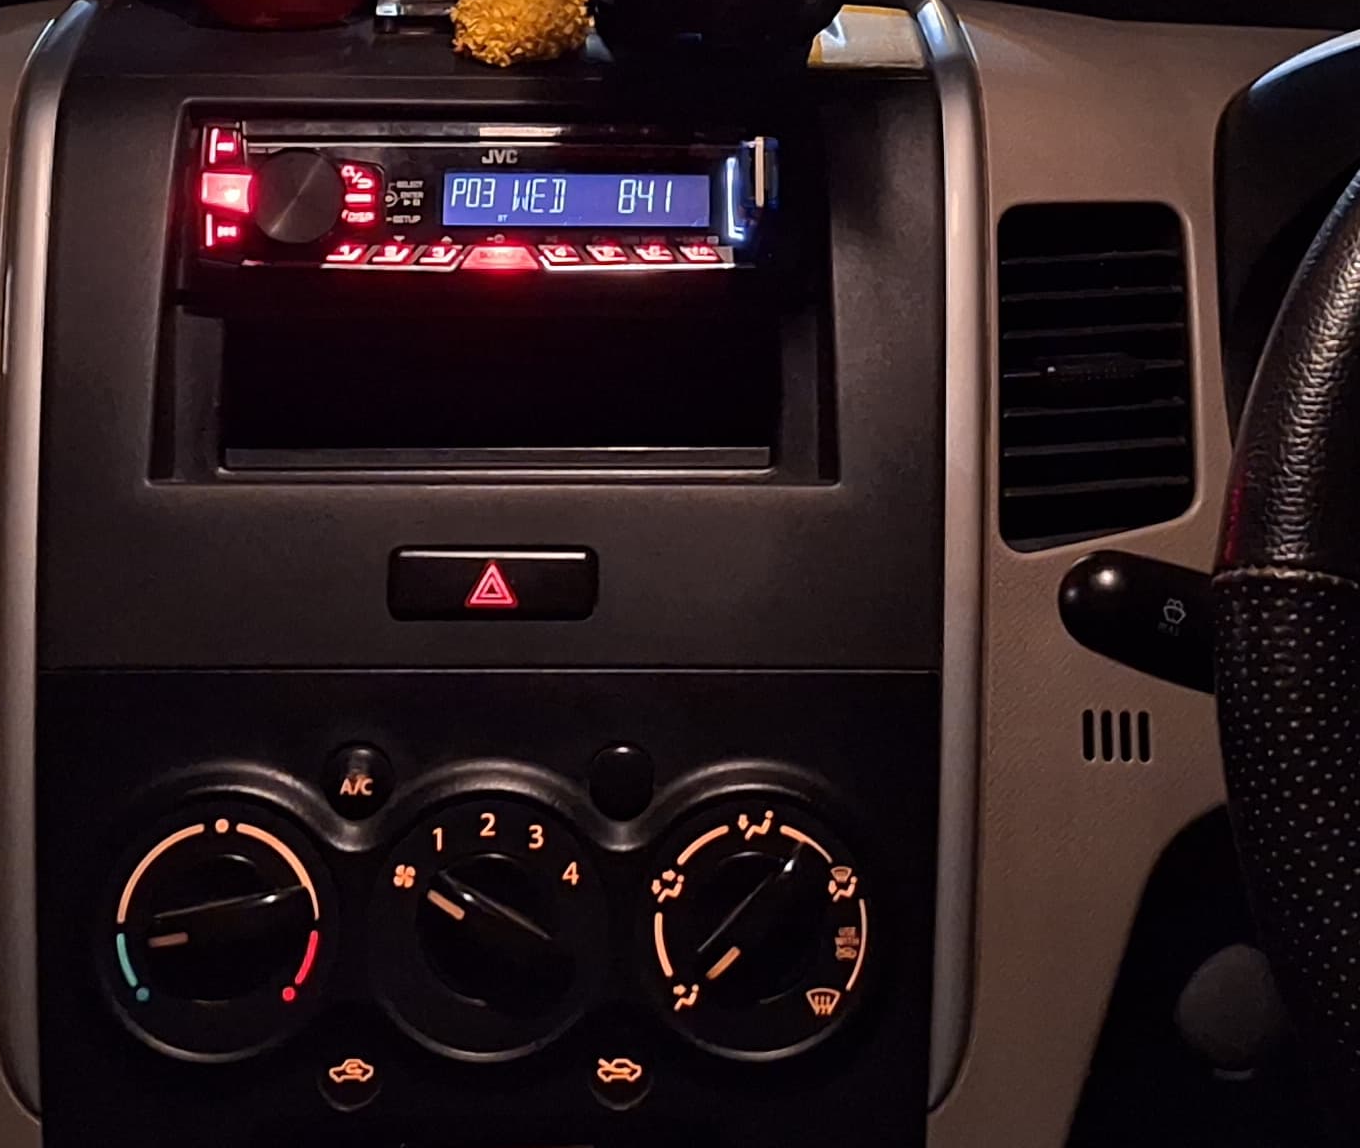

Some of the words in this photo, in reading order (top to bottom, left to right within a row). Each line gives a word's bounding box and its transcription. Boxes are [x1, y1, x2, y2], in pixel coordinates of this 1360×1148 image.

[481, 149, 519, 164] JVC
[451, 178, 496, 208] P03
[511, 178, 567, 213] WED
[340, 777, 373, 796] A/C
[479, 812, 496, 837] 2
[528, 824, 544, 849] 3
[432, 827, 443, 852] 1
[562, 861, 579, 886] 4
